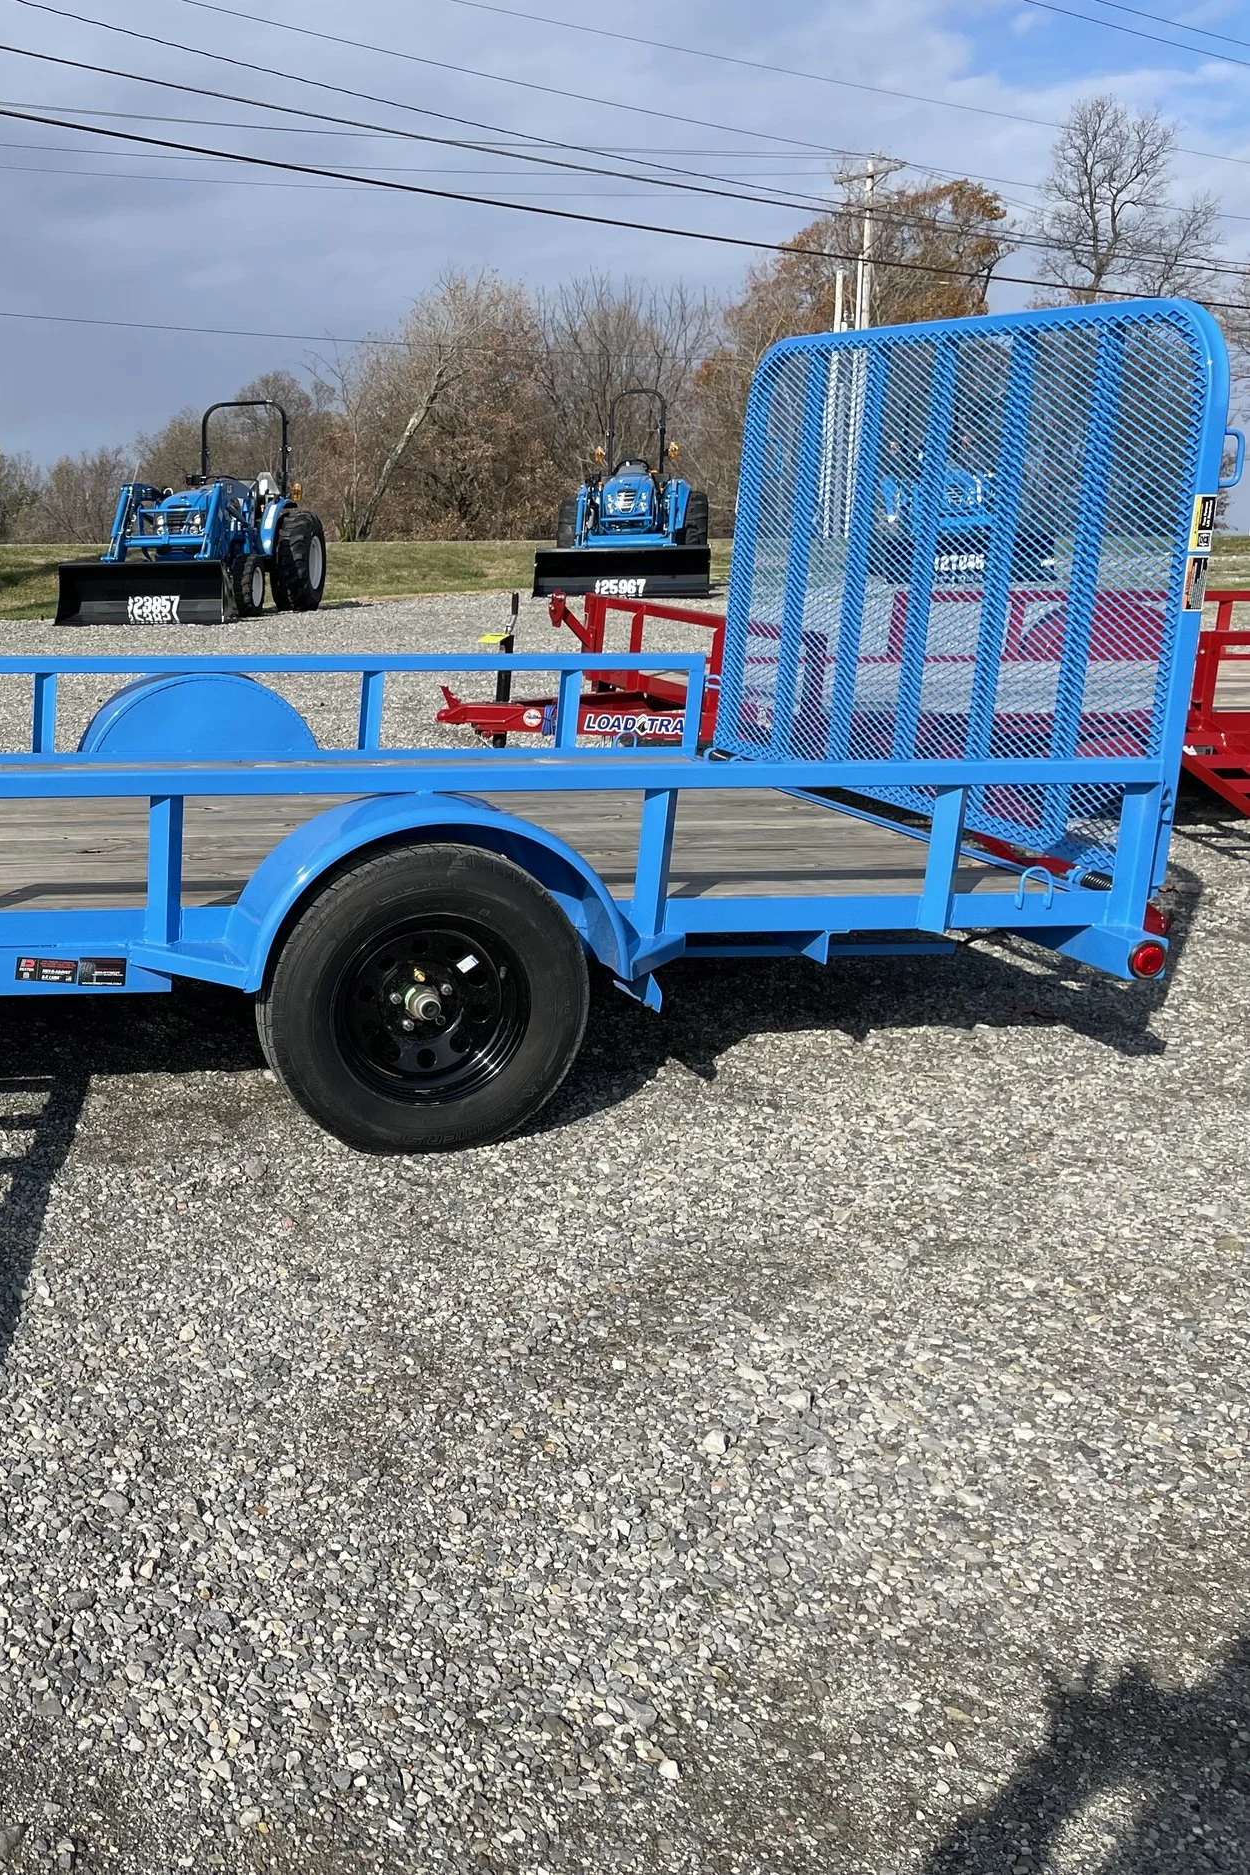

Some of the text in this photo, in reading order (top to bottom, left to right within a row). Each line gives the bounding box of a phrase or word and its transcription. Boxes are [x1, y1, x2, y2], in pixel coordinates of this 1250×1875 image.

[594, 578, 646, 595] $25967
[127, 596, 180, 613] $23857
[585, 714, 684, 735] LOAD TRA
